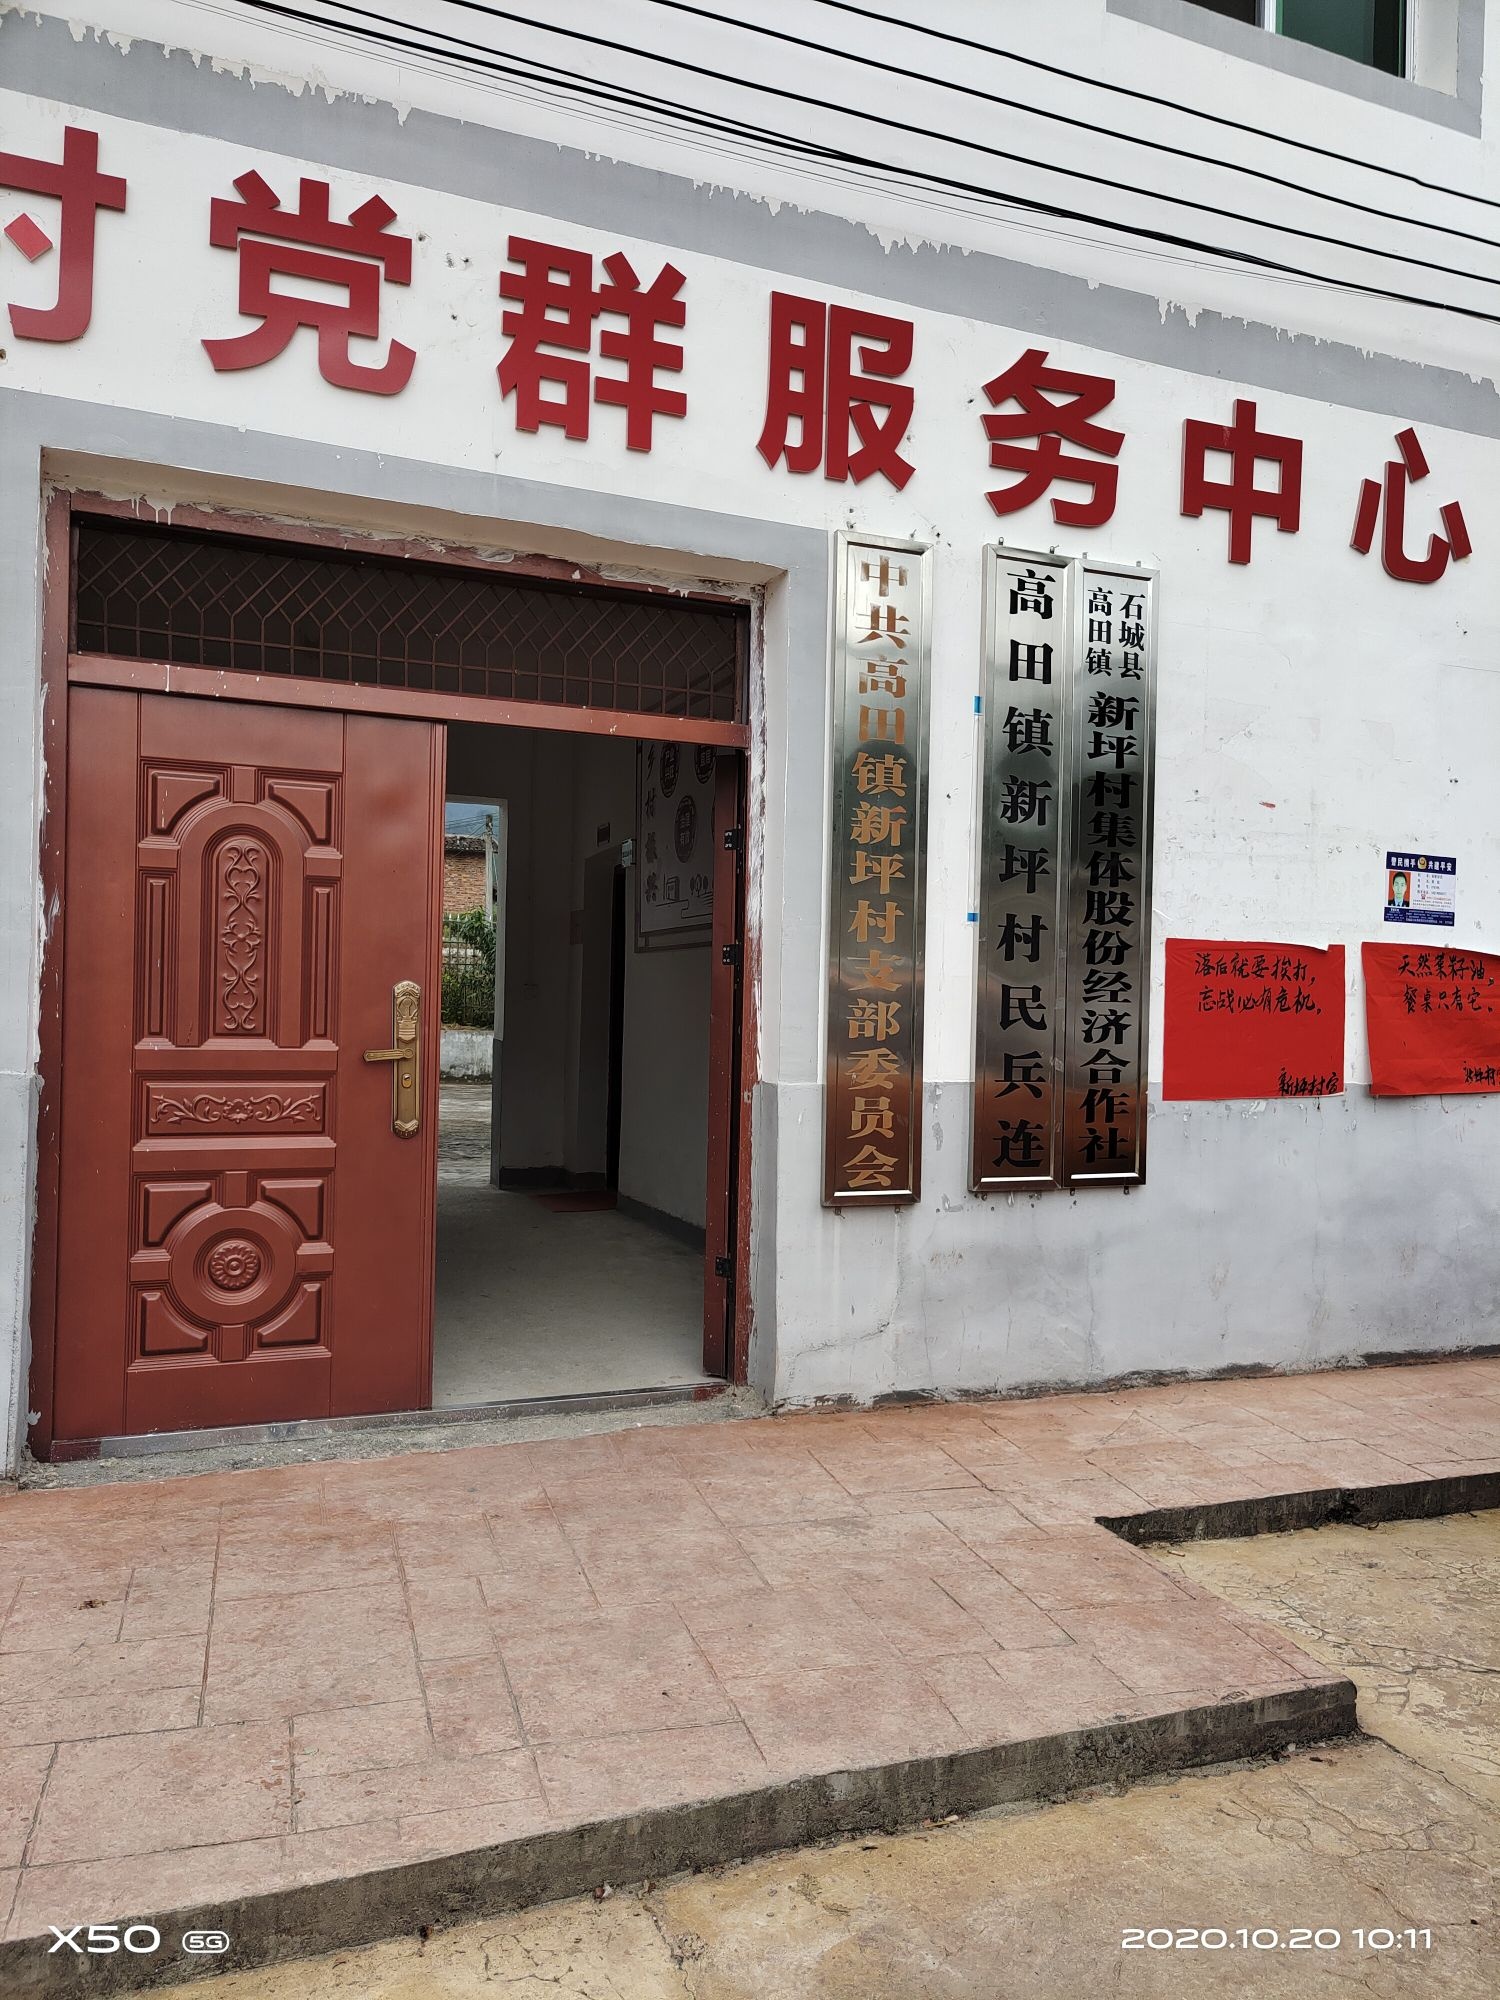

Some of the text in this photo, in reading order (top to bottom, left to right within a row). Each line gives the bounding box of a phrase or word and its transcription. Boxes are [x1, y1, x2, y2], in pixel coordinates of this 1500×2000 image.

[1085, 587, 1113, 677] 高田镇
[1119, 592, 1146, 681] 石城县
[843, 555, 911, 1188] 中共高田镇新坪村支部委员会
[992, 569, 1056, 1168] 高田镇新坪村民兵连
[1078, 691, 1140, 1163] 新坪村集体股份经济合作社
